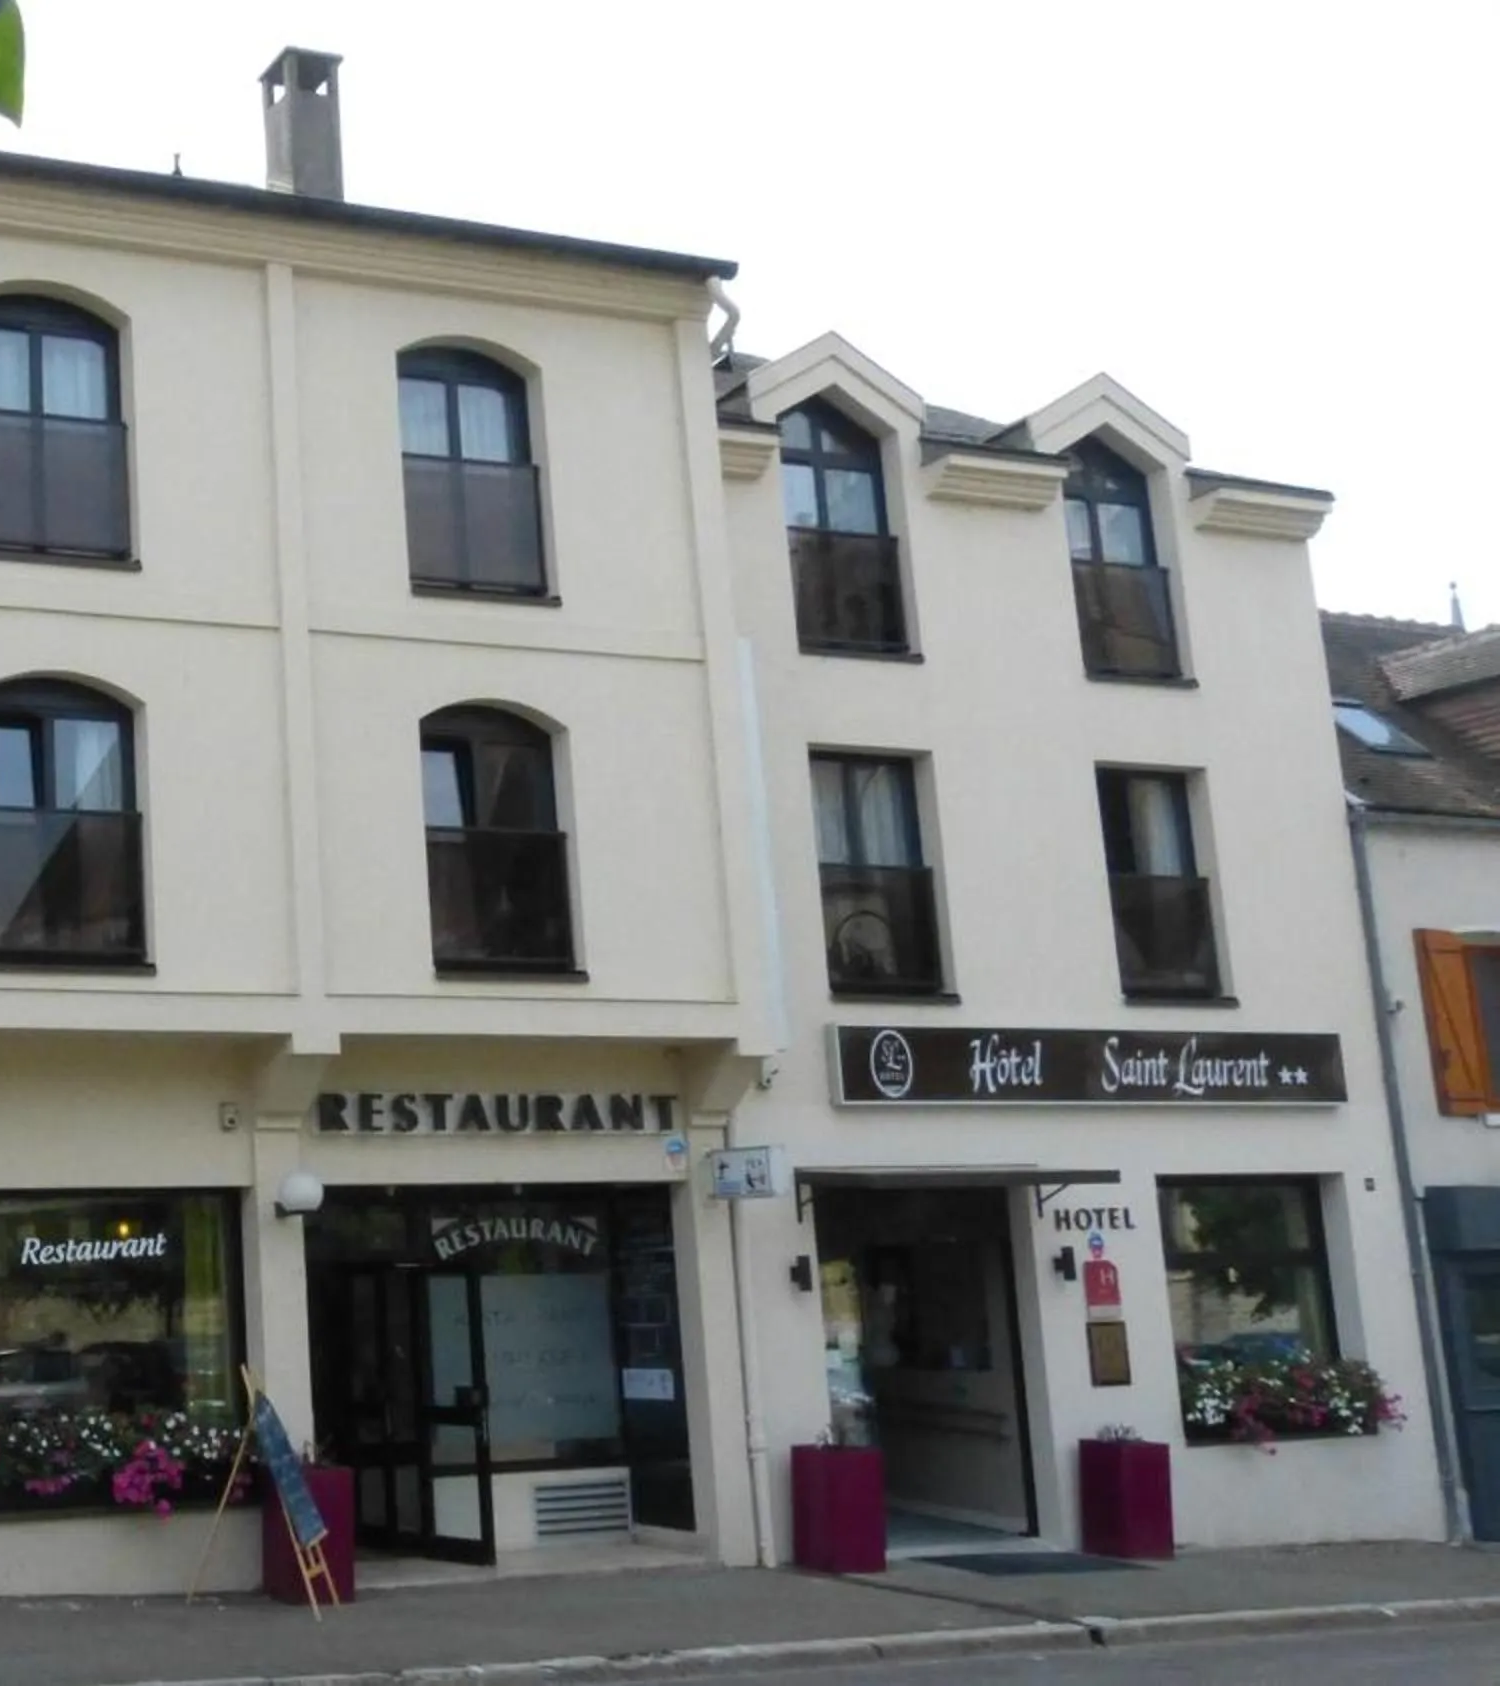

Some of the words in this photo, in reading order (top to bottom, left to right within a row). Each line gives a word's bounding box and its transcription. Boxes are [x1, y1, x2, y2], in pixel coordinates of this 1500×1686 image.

[969, 1034, 1043, 1093] Hôtel
[1101, 1036, 1168, 1092] Saint
[1172, 1036, 1270, 1095] Laurent
[317, 1093, 678, 1132] RESTAURANT
[1053, 1206, 1137, 1232] HOTEL
[20, 1232, 168, 1265] Restaurant
[434, 1217, 597, 1261] RESTAURANT
